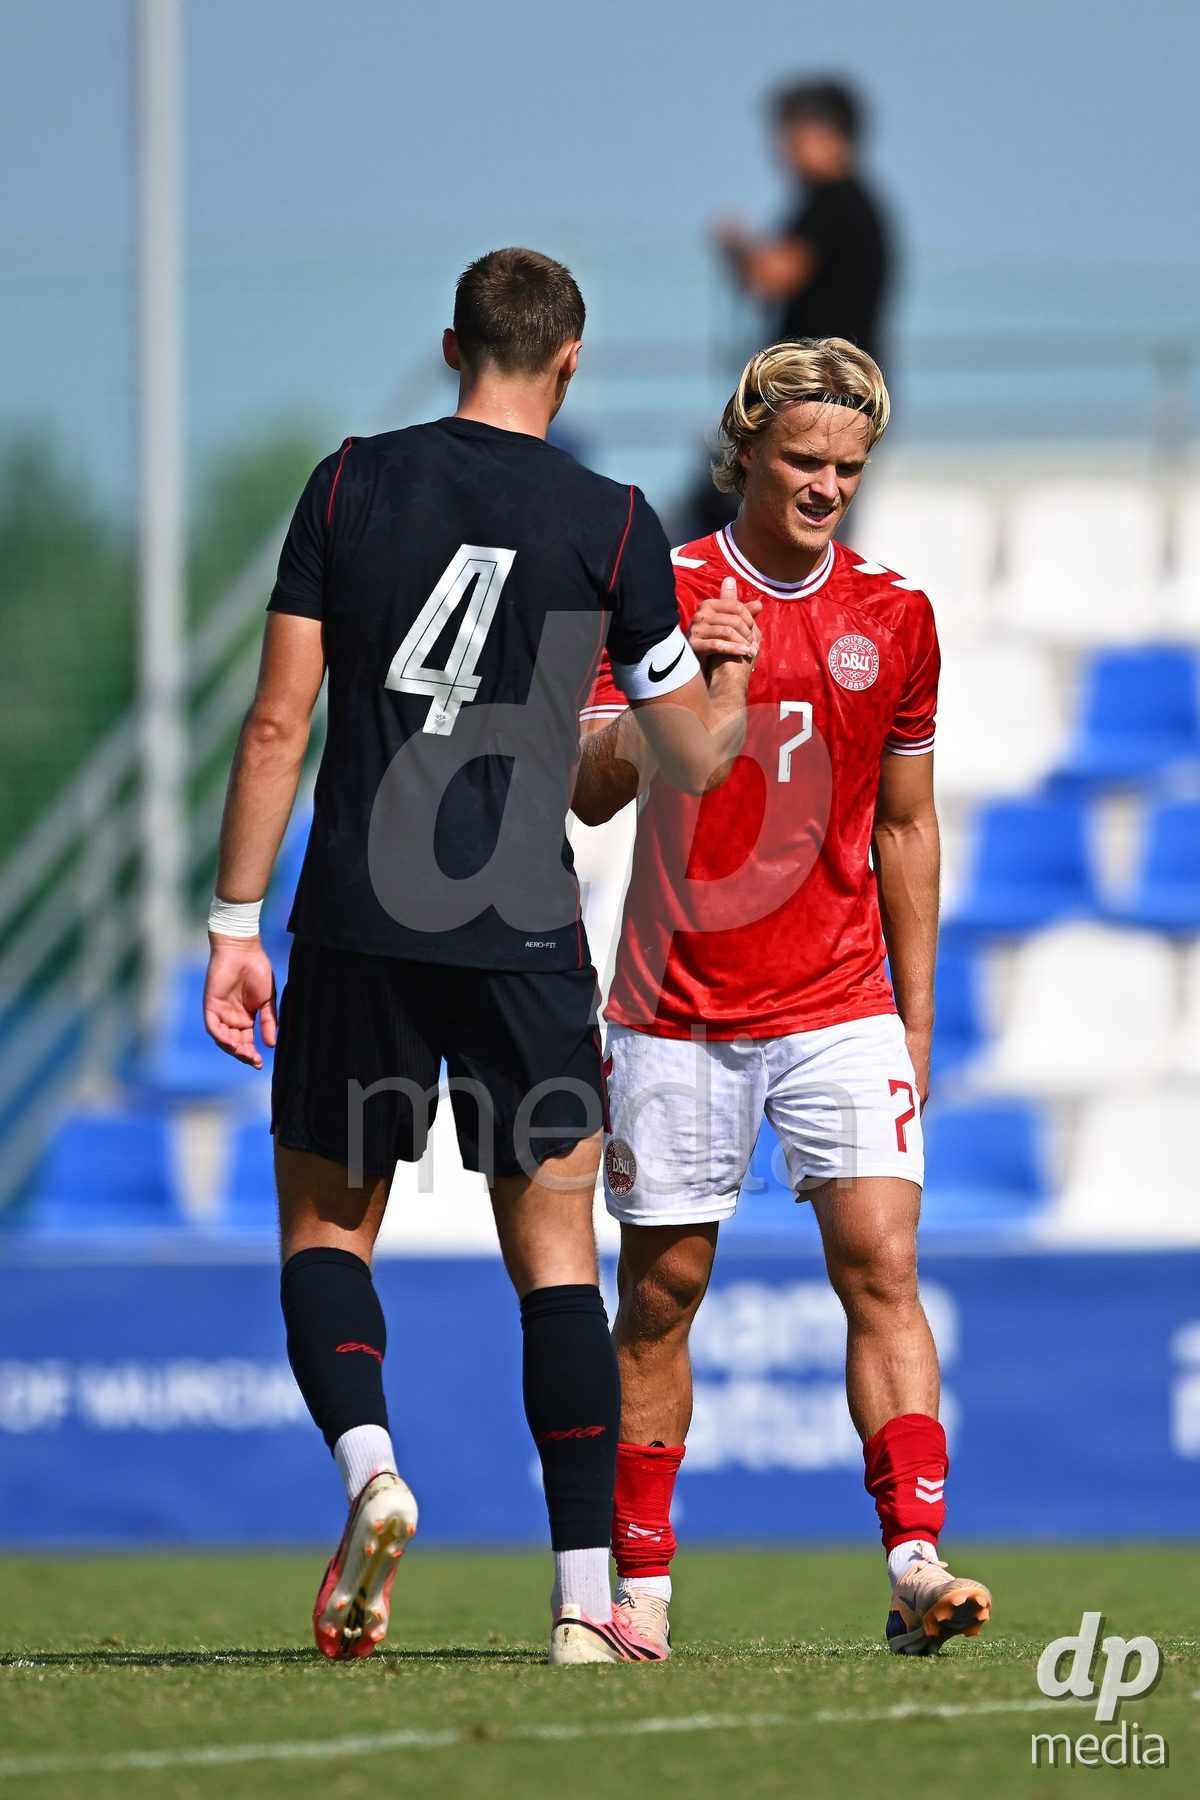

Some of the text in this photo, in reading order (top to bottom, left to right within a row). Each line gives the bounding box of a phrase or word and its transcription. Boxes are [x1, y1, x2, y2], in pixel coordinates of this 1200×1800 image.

[384, 543, 517, 736] 4
[830, 648, 842, 681] DANSK
[865, 655, 878, 684] UNION
[840, 652, 870, 671] DBU
[843, 680, 865, 689] 1889
[778, 700, 814, 783] 7
[524, 941, 557, 949] AERO-FIT
[888, 1079, 916, 1154] 7
[612, 1157, 630, 1175] DBU
